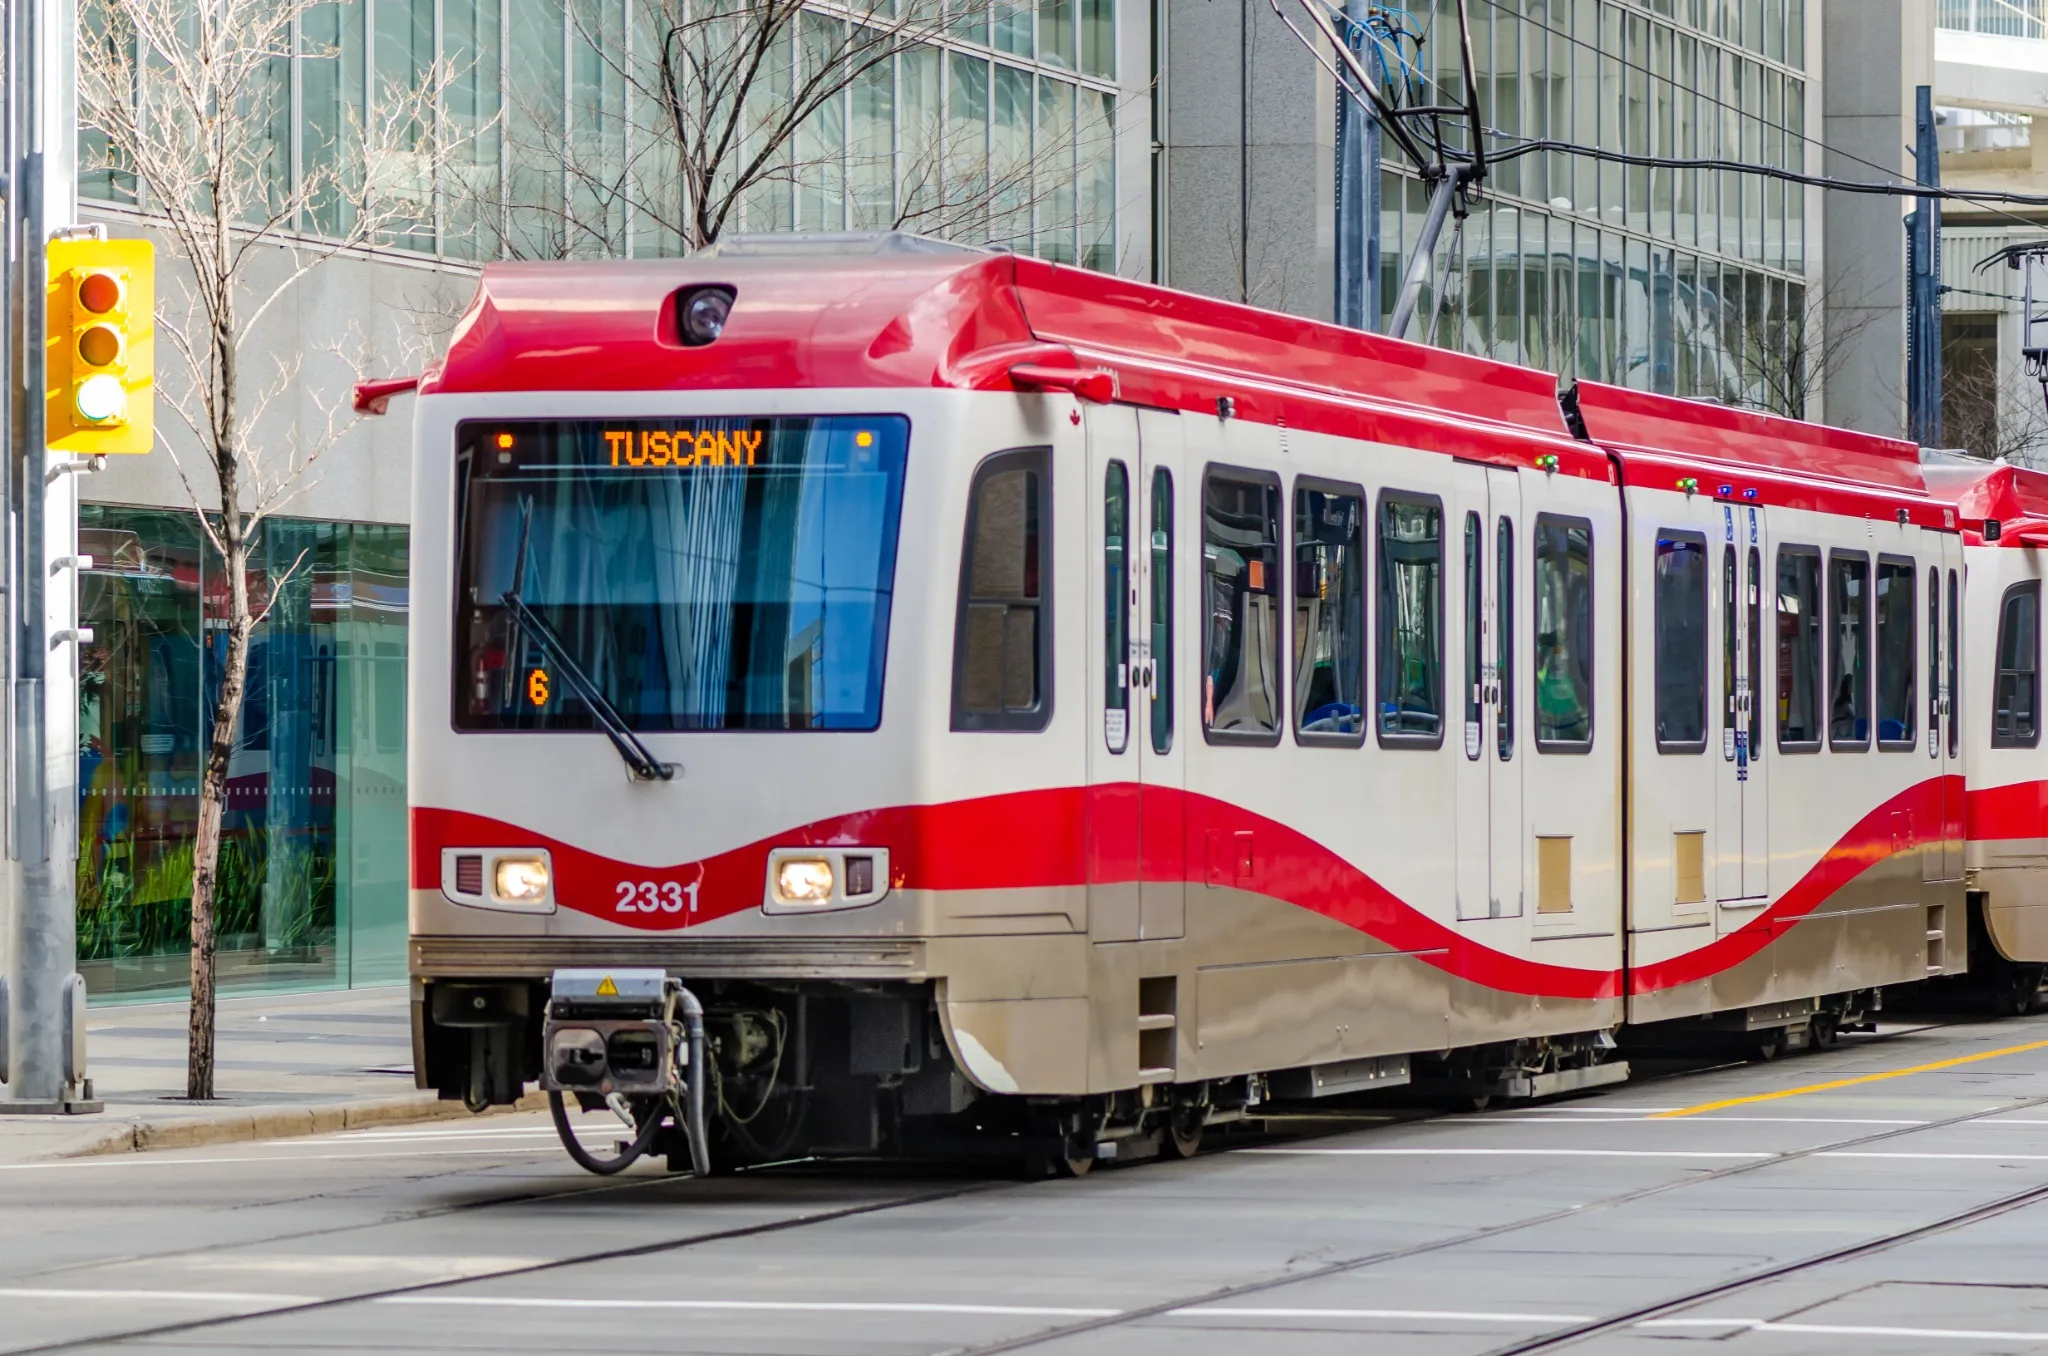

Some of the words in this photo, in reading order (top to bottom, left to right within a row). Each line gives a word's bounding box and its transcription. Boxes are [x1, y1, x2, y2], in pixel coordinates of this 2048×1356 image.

[604, 430, 762, 467] TUSCANY
[529, 669, 549, 706] 6
[615, 881, 698, 912] 2331
